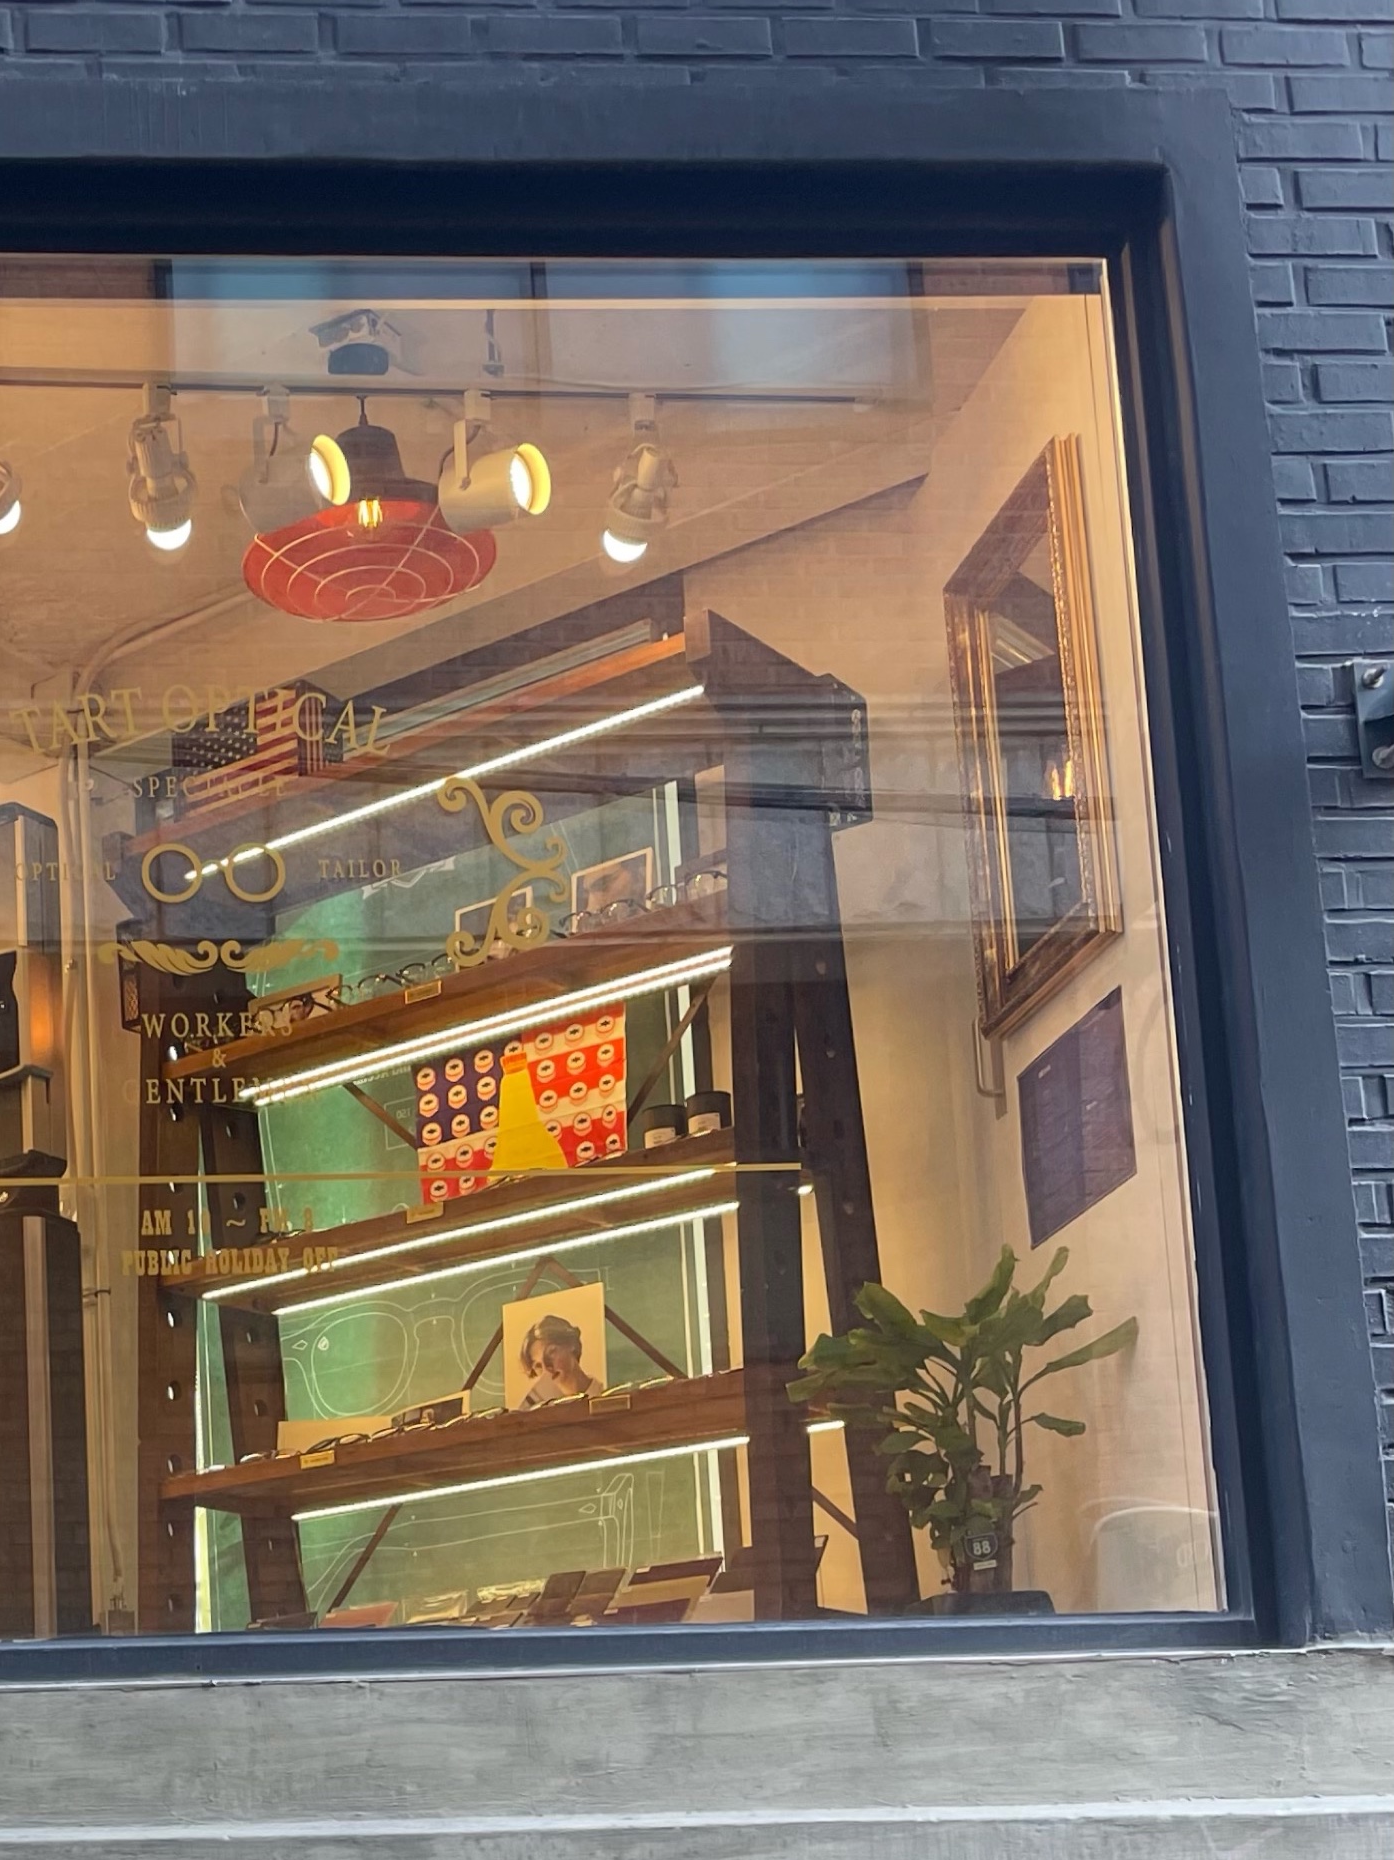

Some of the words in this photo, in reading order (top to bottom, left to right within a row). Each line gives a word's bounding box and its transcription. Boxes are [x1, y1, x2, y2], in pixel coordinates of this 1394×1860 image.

[10, 688, 142, 753] TART
[162, 684, 391, 756] OPTICAL
[14, 861, 116, 882] OPTIL
[317, 857, 403, 879] TAILOR
[141, 1012, 293, 1039] WORKERS
[212, 1048, 227, 1068] &
[123, 1076, 308, 1104] GENTLE
[141, 1209, 172, 1235] AM
[121, 1249, 193, 1276] PUBLIC
[206, 1247, 290, 1275] HOLIDAY
[302, 1246, 339, 1274] OFF
